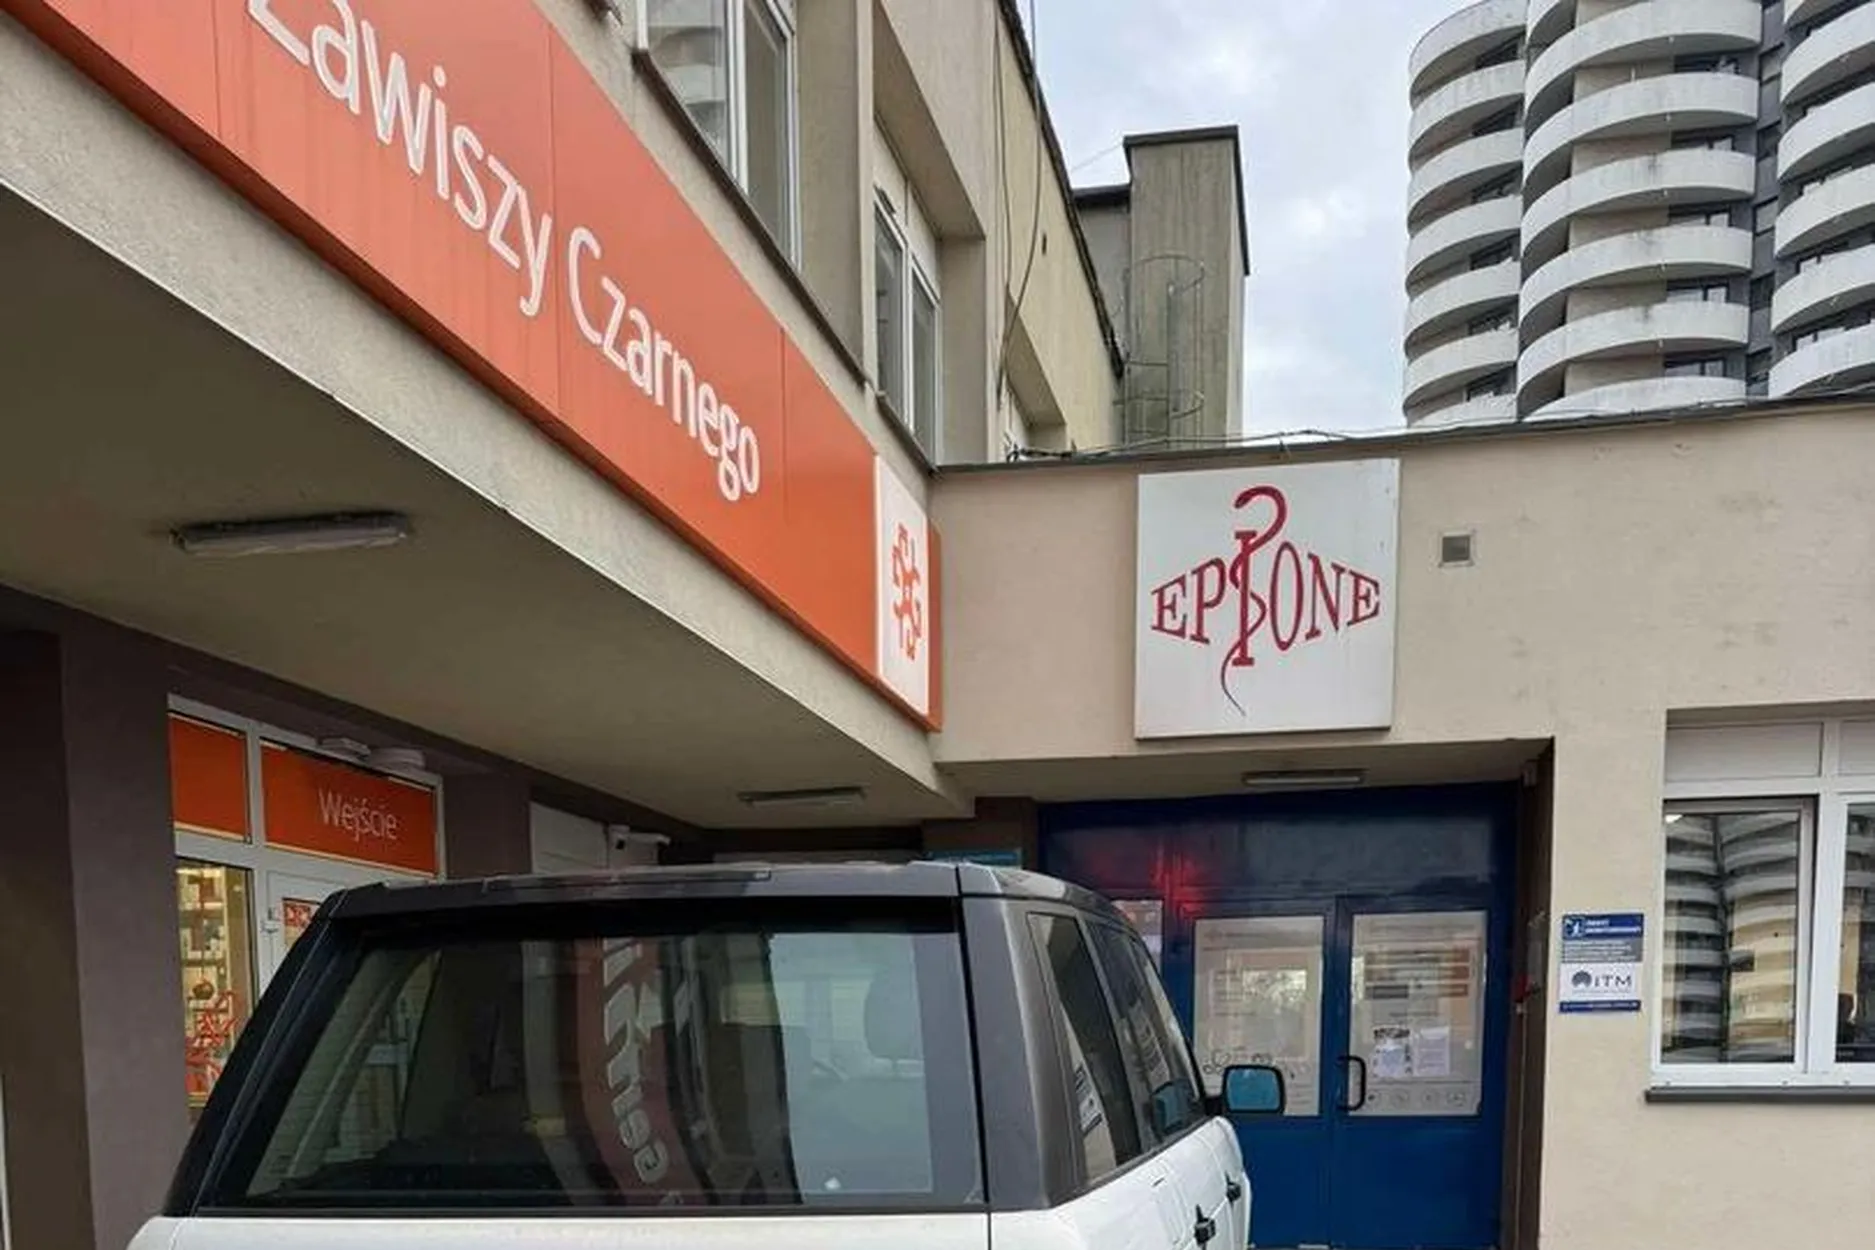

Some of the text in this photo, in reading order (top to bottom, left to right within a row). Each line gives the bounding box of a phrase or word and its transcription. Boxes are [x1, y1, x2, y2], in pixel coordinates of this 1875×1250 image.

[568, 226, 762, 503] Czarnego
[1150, 530, 1381, 667] EPIONE
[317, 786, 398, 843] Wejście
